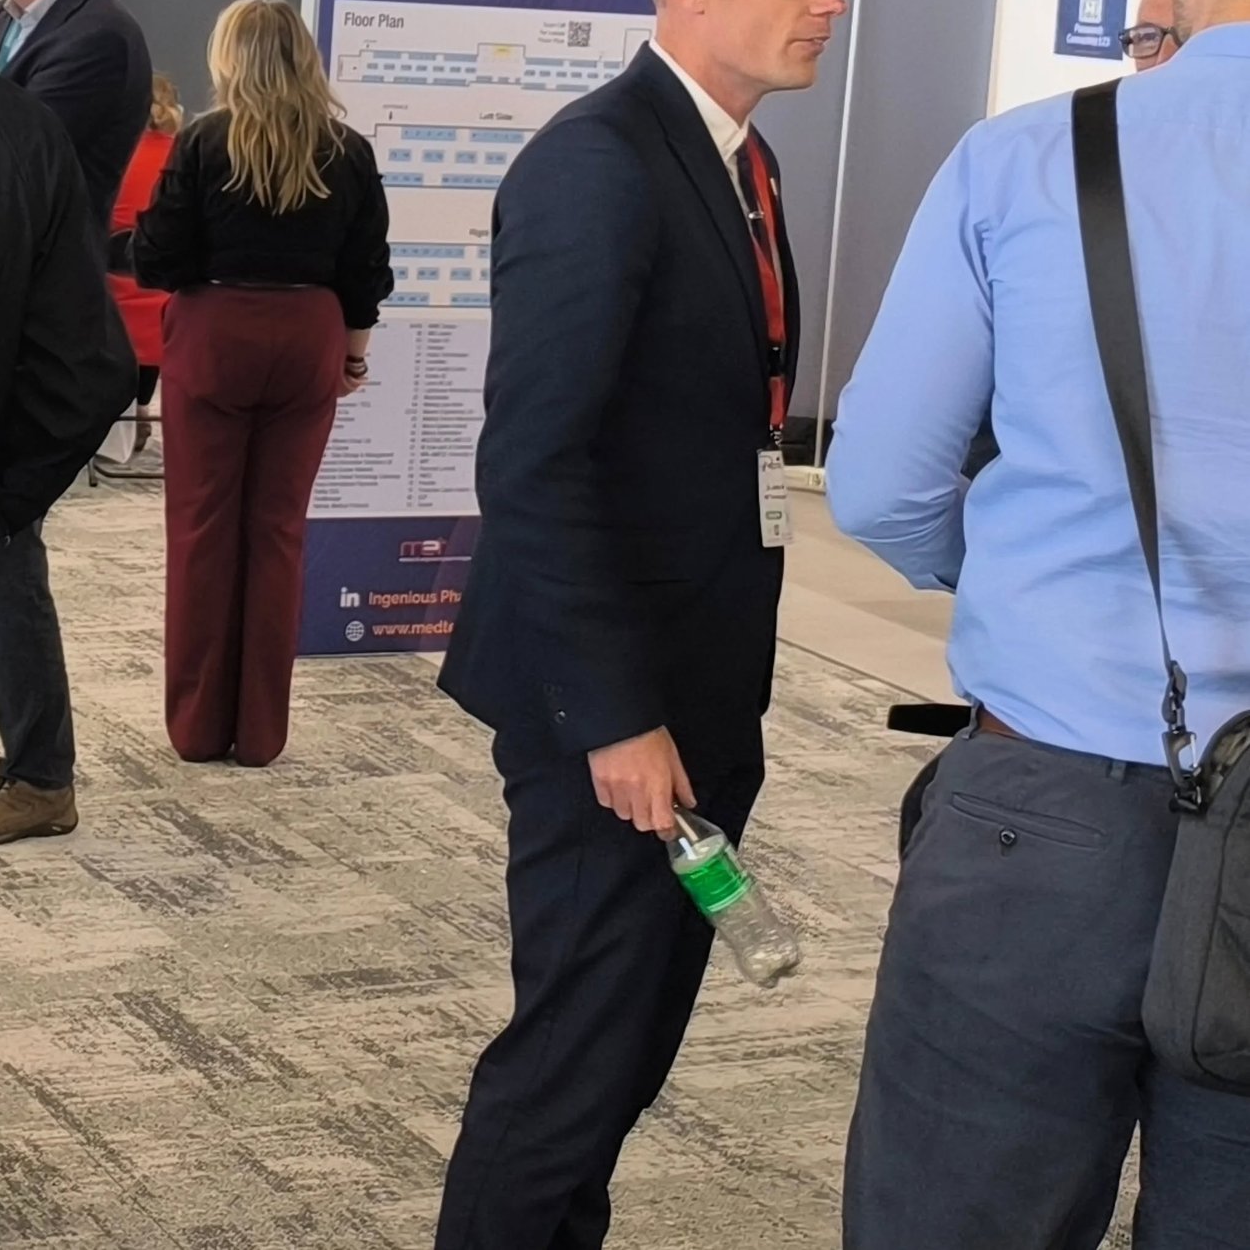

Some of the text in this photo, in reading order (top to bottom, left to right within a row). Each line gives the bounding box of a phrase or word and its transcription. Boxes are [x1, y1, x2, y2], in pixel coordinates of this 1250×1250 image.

[344, 11, 405, 29] Floor Plan
[368, 590, 437, 608] Ingenious
